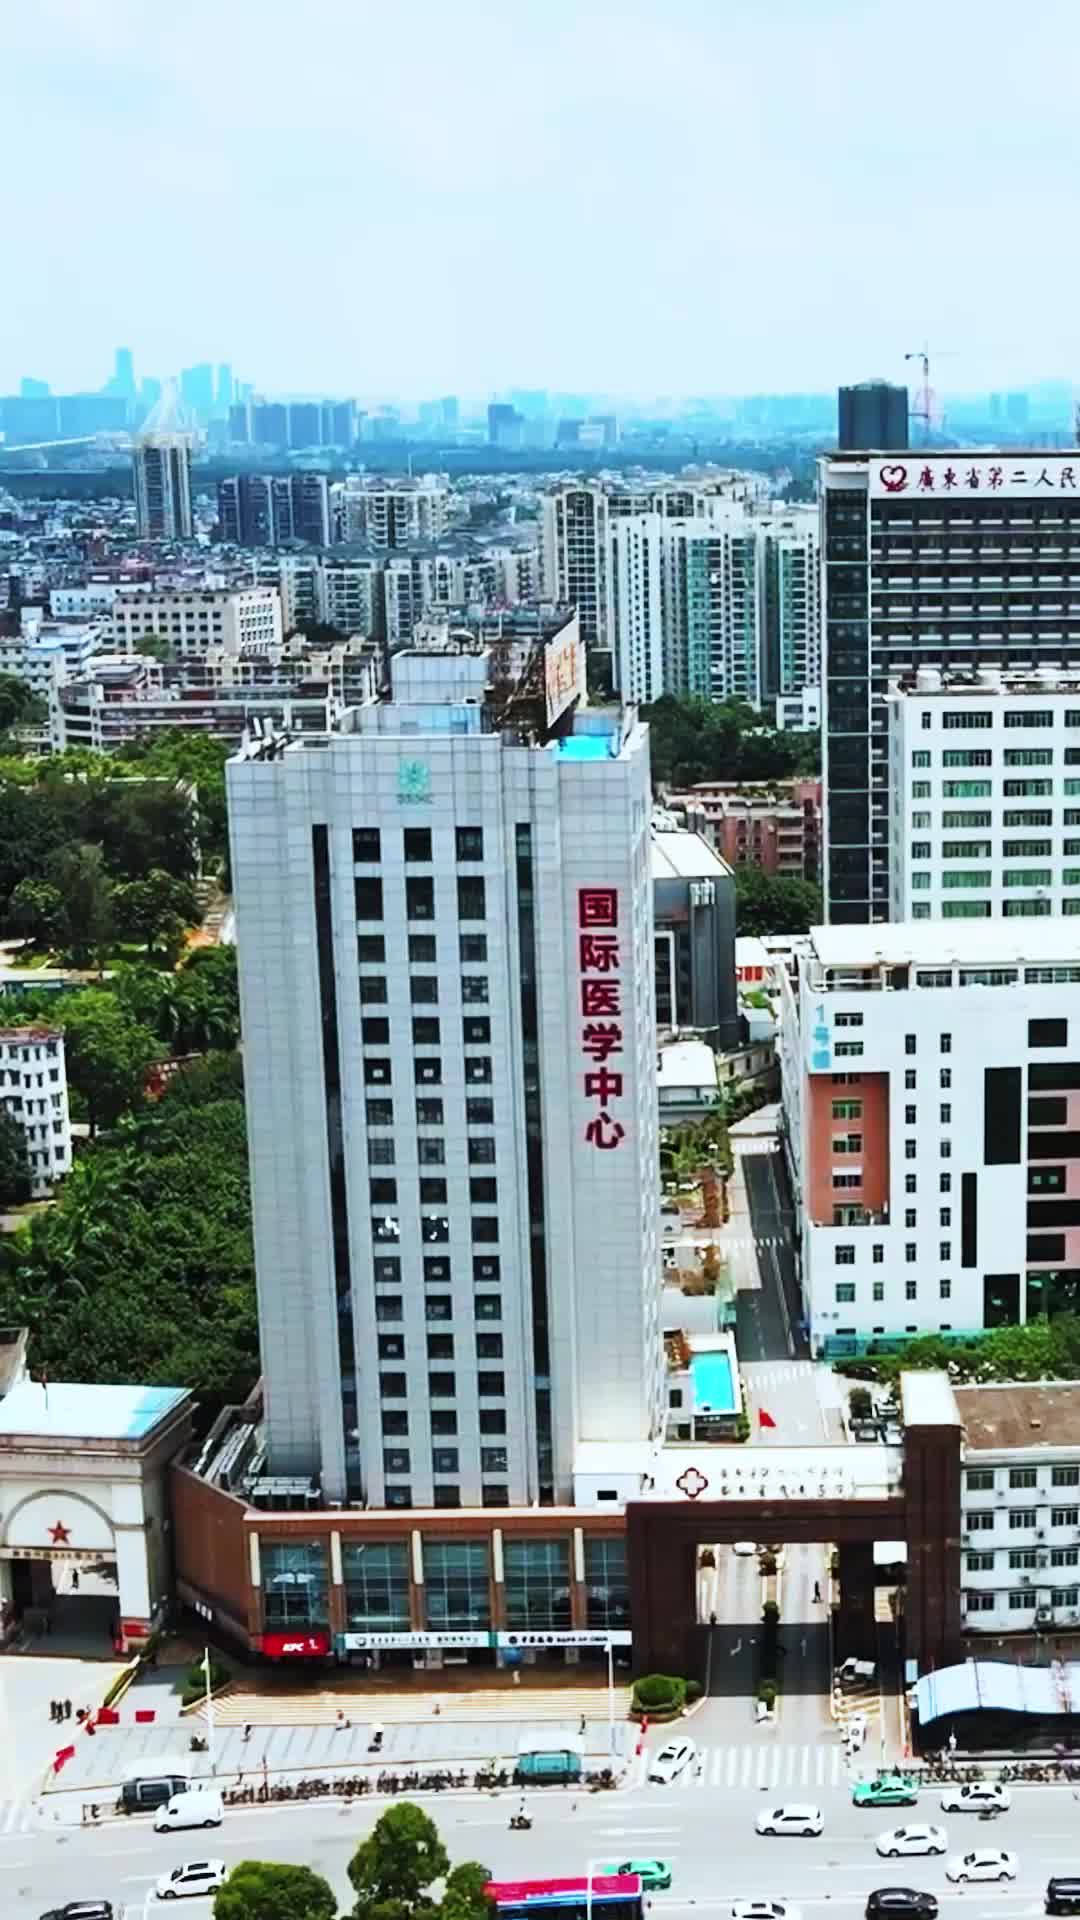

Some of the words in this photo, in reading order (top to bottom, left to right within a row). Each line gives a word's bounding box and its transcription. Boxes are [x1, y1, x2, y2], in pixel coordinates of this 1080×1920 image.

[578, 888, 625, 1150] 国际医学中心
